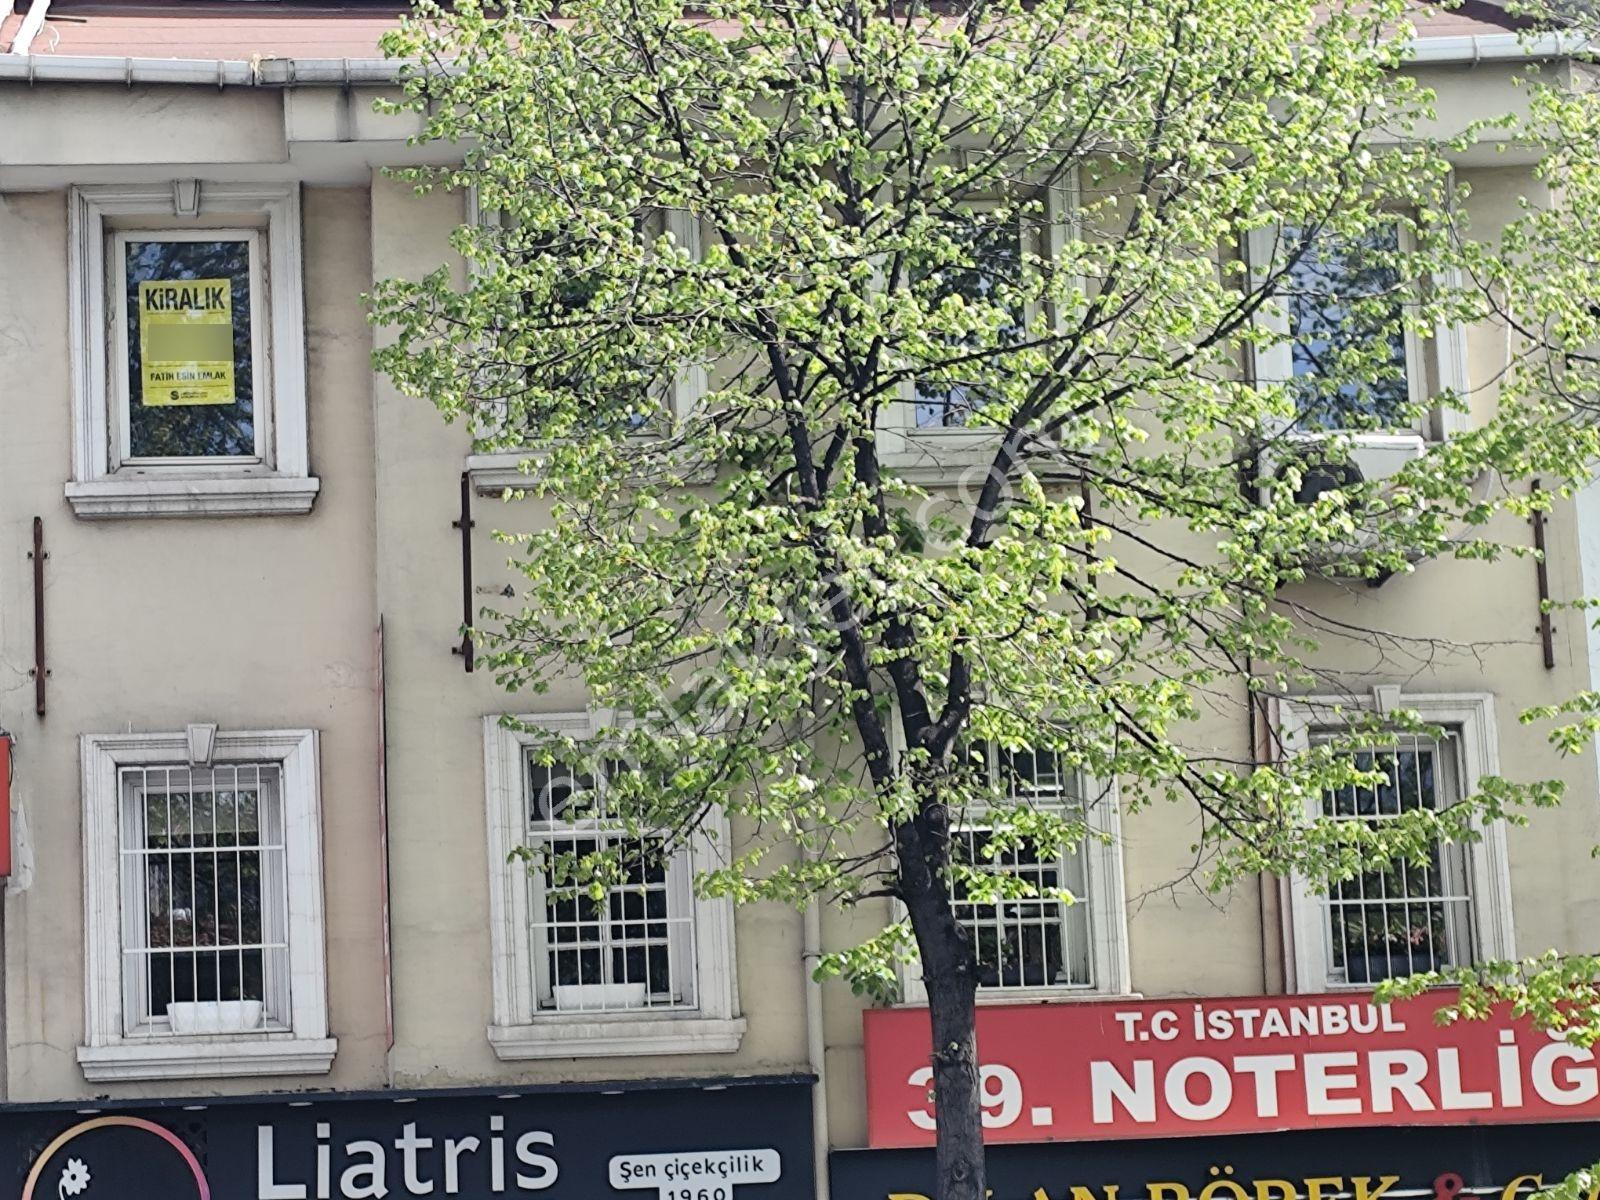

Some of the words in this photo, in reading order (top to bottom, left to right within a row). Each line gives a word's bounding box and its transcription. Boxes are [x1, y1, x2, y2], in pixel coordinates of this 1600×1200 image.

[1115, 1011, 1180, 1042] T.C
[1194, 1002, 1406, 1041] İSTANBUL
[257, 1115, 559, 1200] Liatris
[619, 1161, 657, 1183] Şen
[664, 1155, 764, 1181] çiçekçilik
